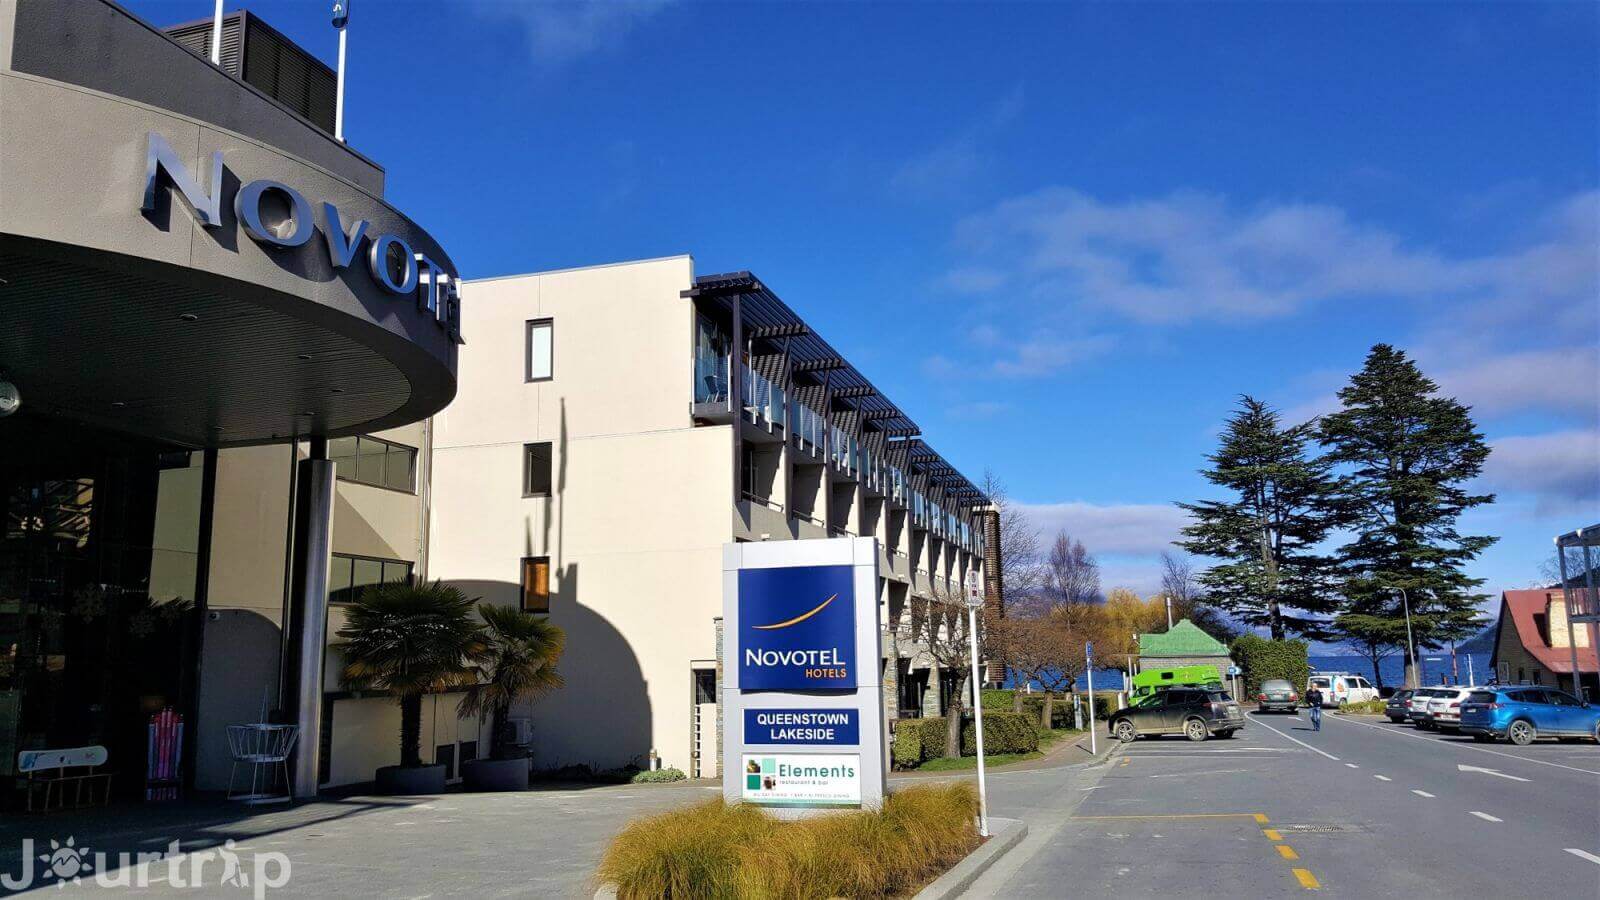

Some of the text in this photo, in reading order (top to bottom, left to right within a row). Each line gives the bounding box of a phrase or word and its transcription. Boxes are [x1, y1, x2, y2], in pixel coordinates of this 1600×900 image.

[141, 131, 463, 342] NOVOTE
[745, 647, 847, 667] NOVOTEL
[805, 668, 847, 678] HOTELS
[757, 713, 849, 725] QUEENSTOWN
[770, 728, 835, 740] LAKESIDE
[779, 764, 855, 777] Elements
